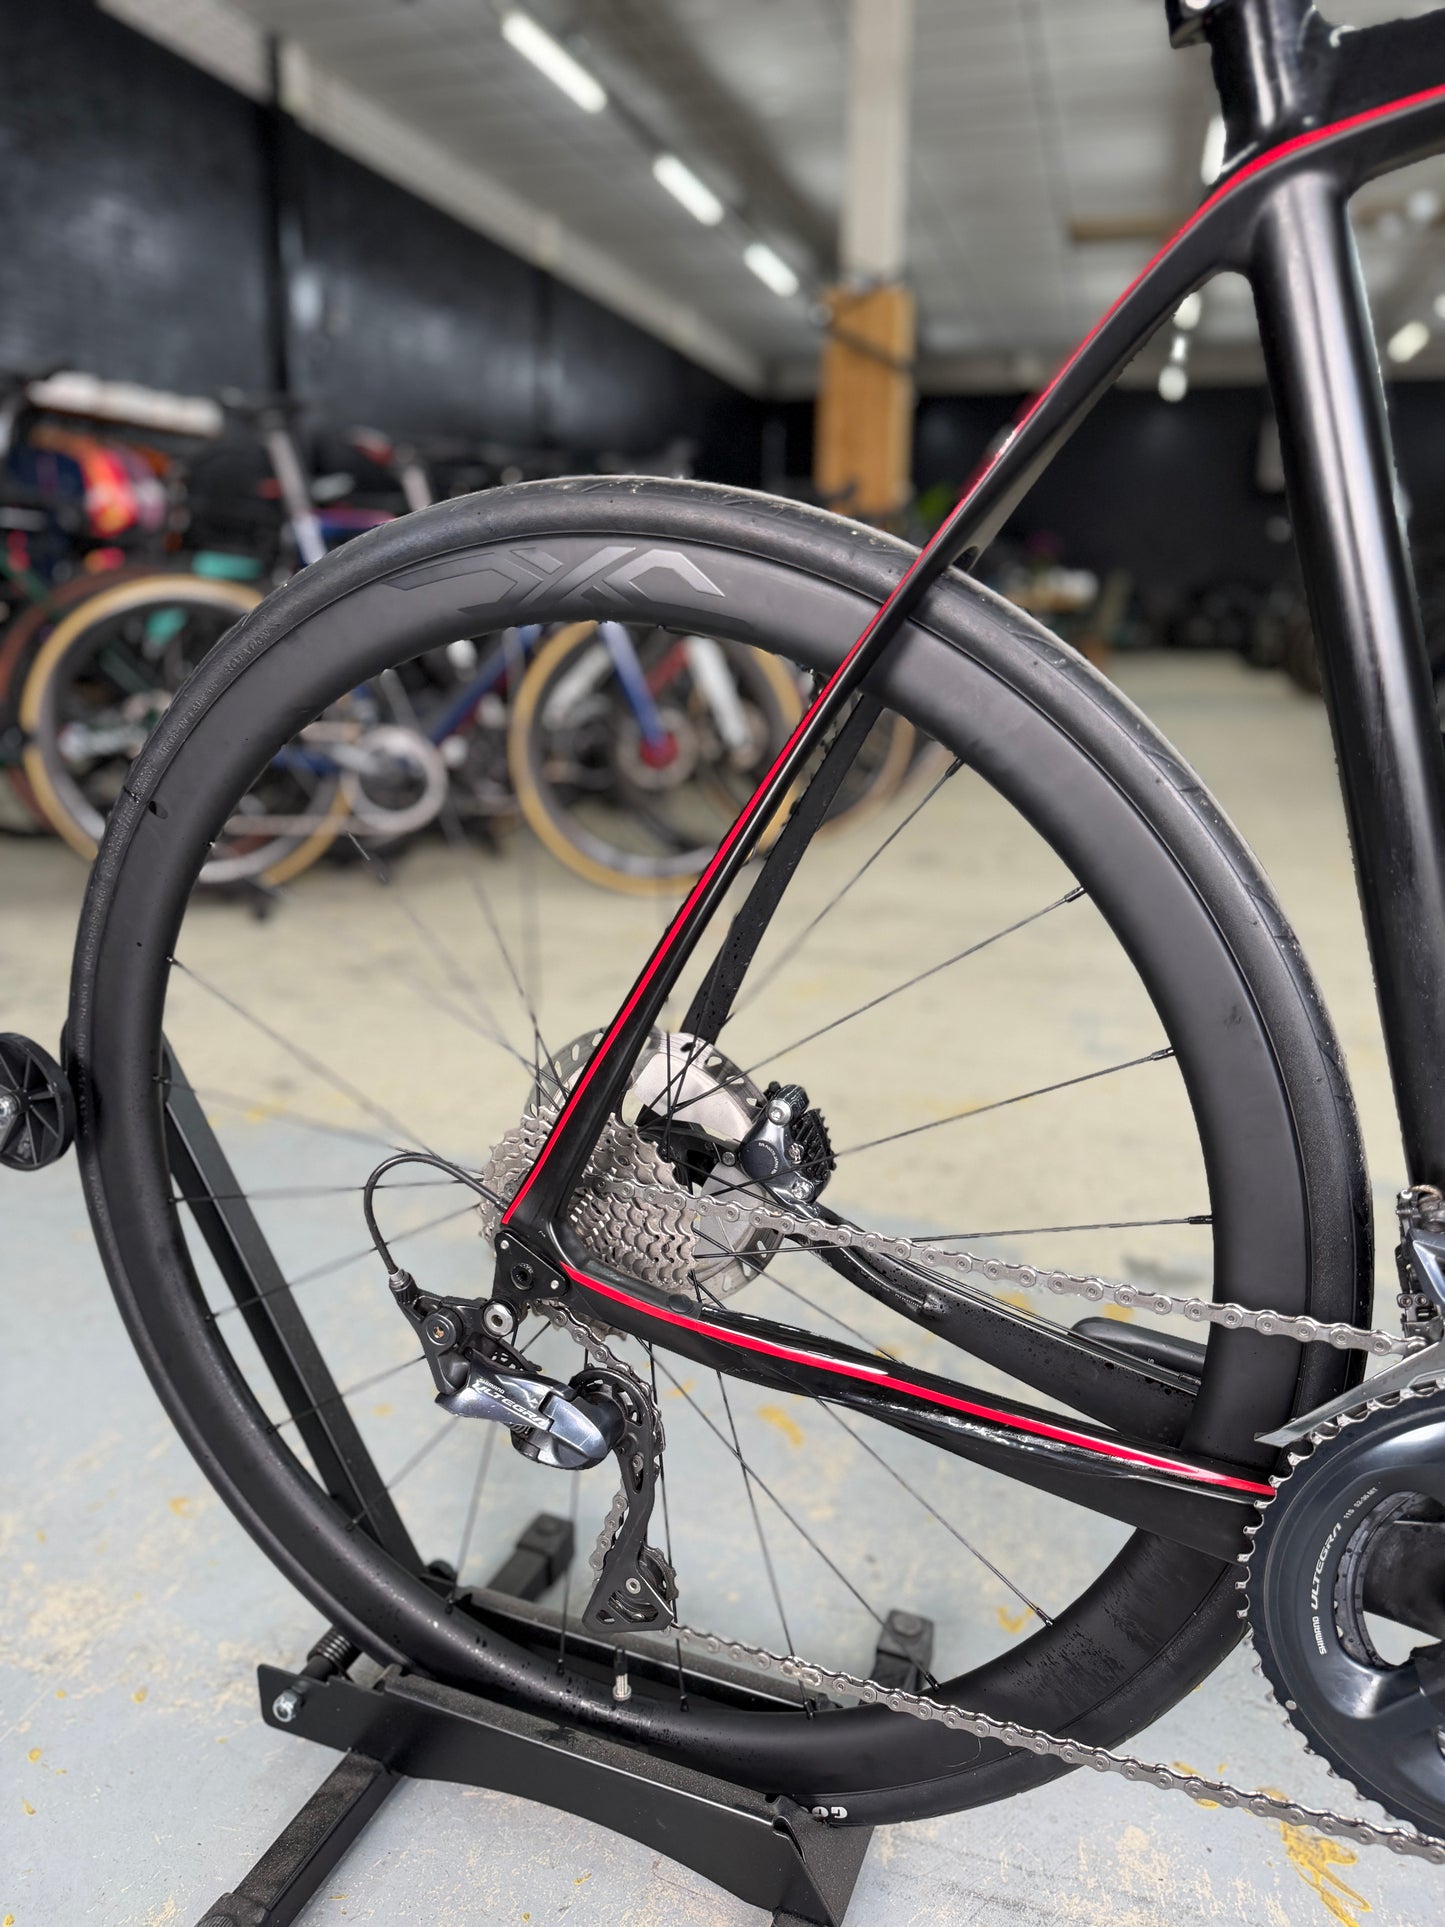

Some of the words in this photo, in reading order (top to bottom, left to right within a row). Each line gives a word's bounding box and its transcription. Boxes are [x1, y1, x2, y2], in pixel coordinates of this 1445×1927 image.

[472, 1379, 550, 1429] ULTEGRA
[1310, 1522, 1343, 1611] ULTEGRA
[1312, 1616, 1328, 1656] SHIMANO
